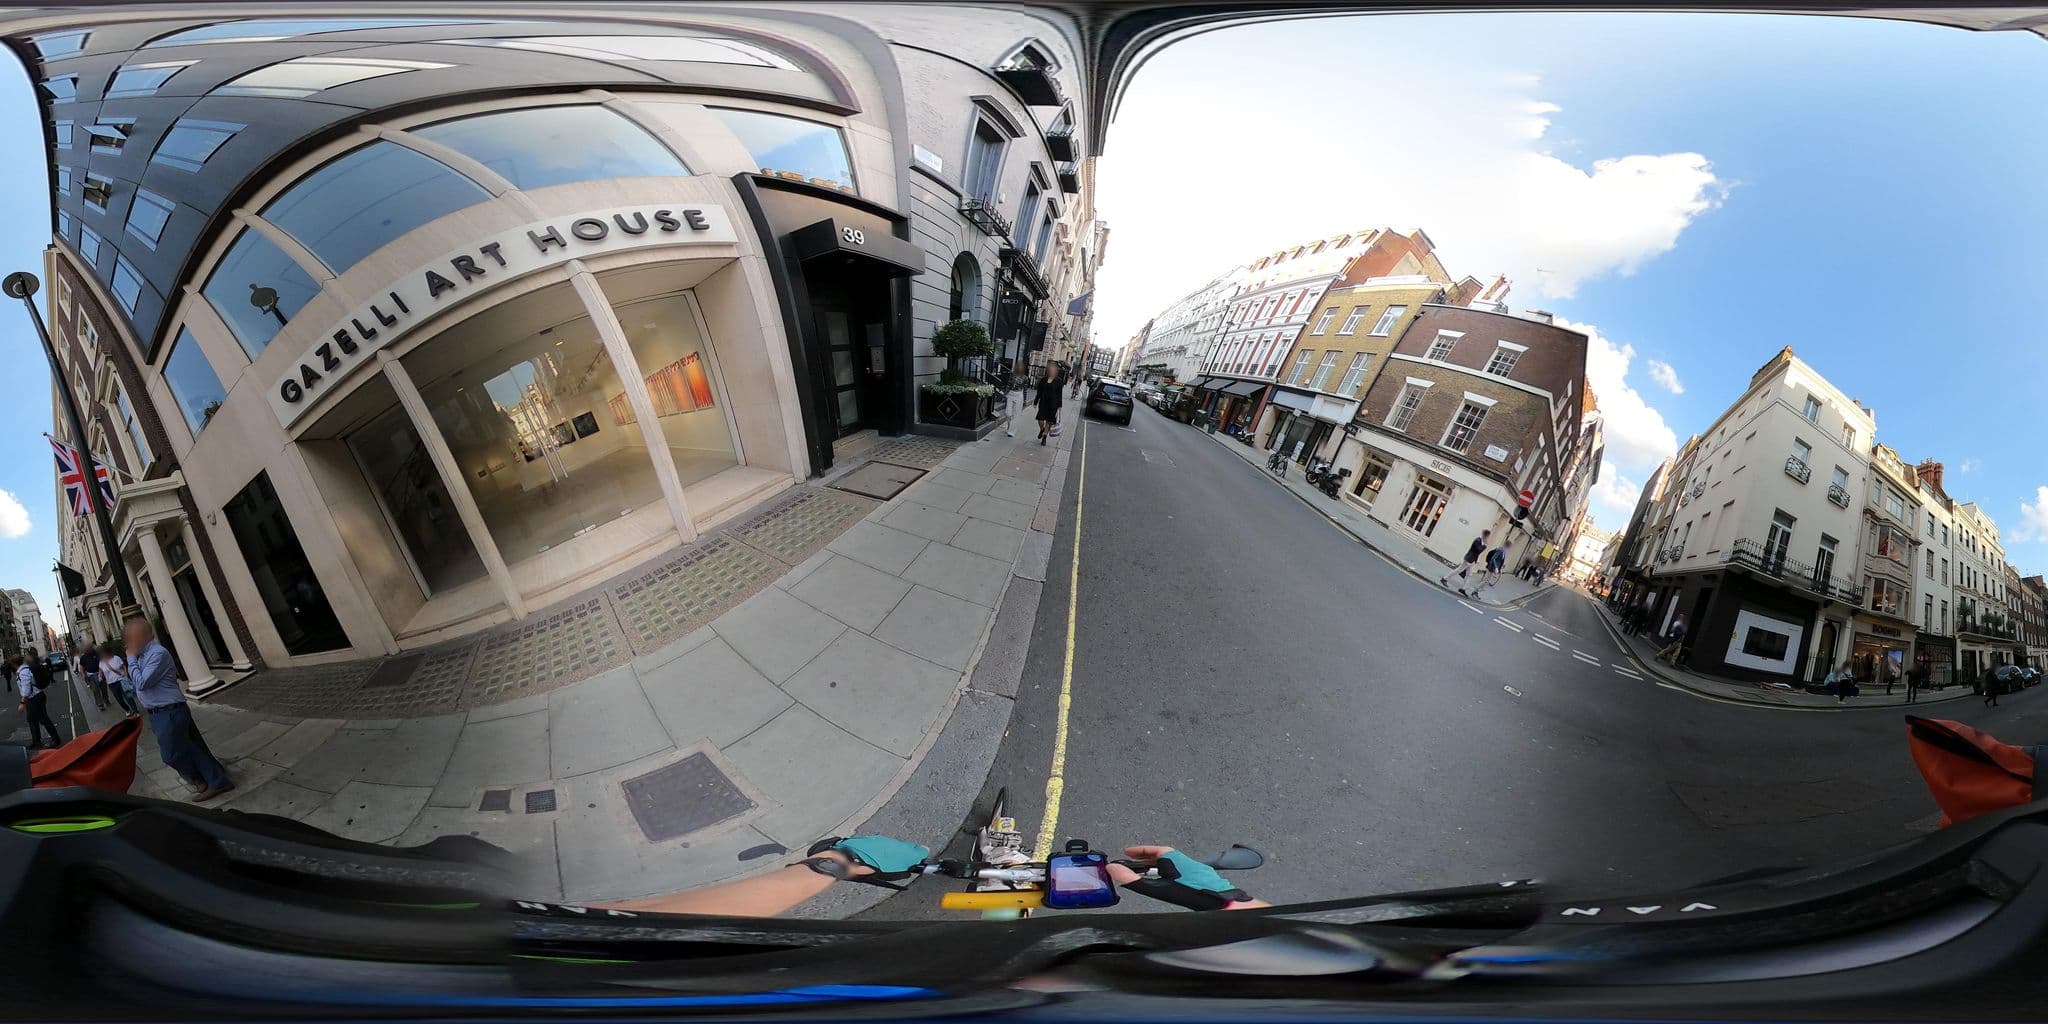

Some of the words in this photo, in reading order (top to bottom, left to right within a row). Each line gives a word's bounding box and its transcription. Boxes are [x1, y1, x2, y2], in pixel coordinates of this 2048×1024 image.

[843, 226, 865, 244] 39
[280, 291, 410, 404] GAZELLI
[424, 241, 509, 298] ART
[527, 208, 711, 254] HOUSE
